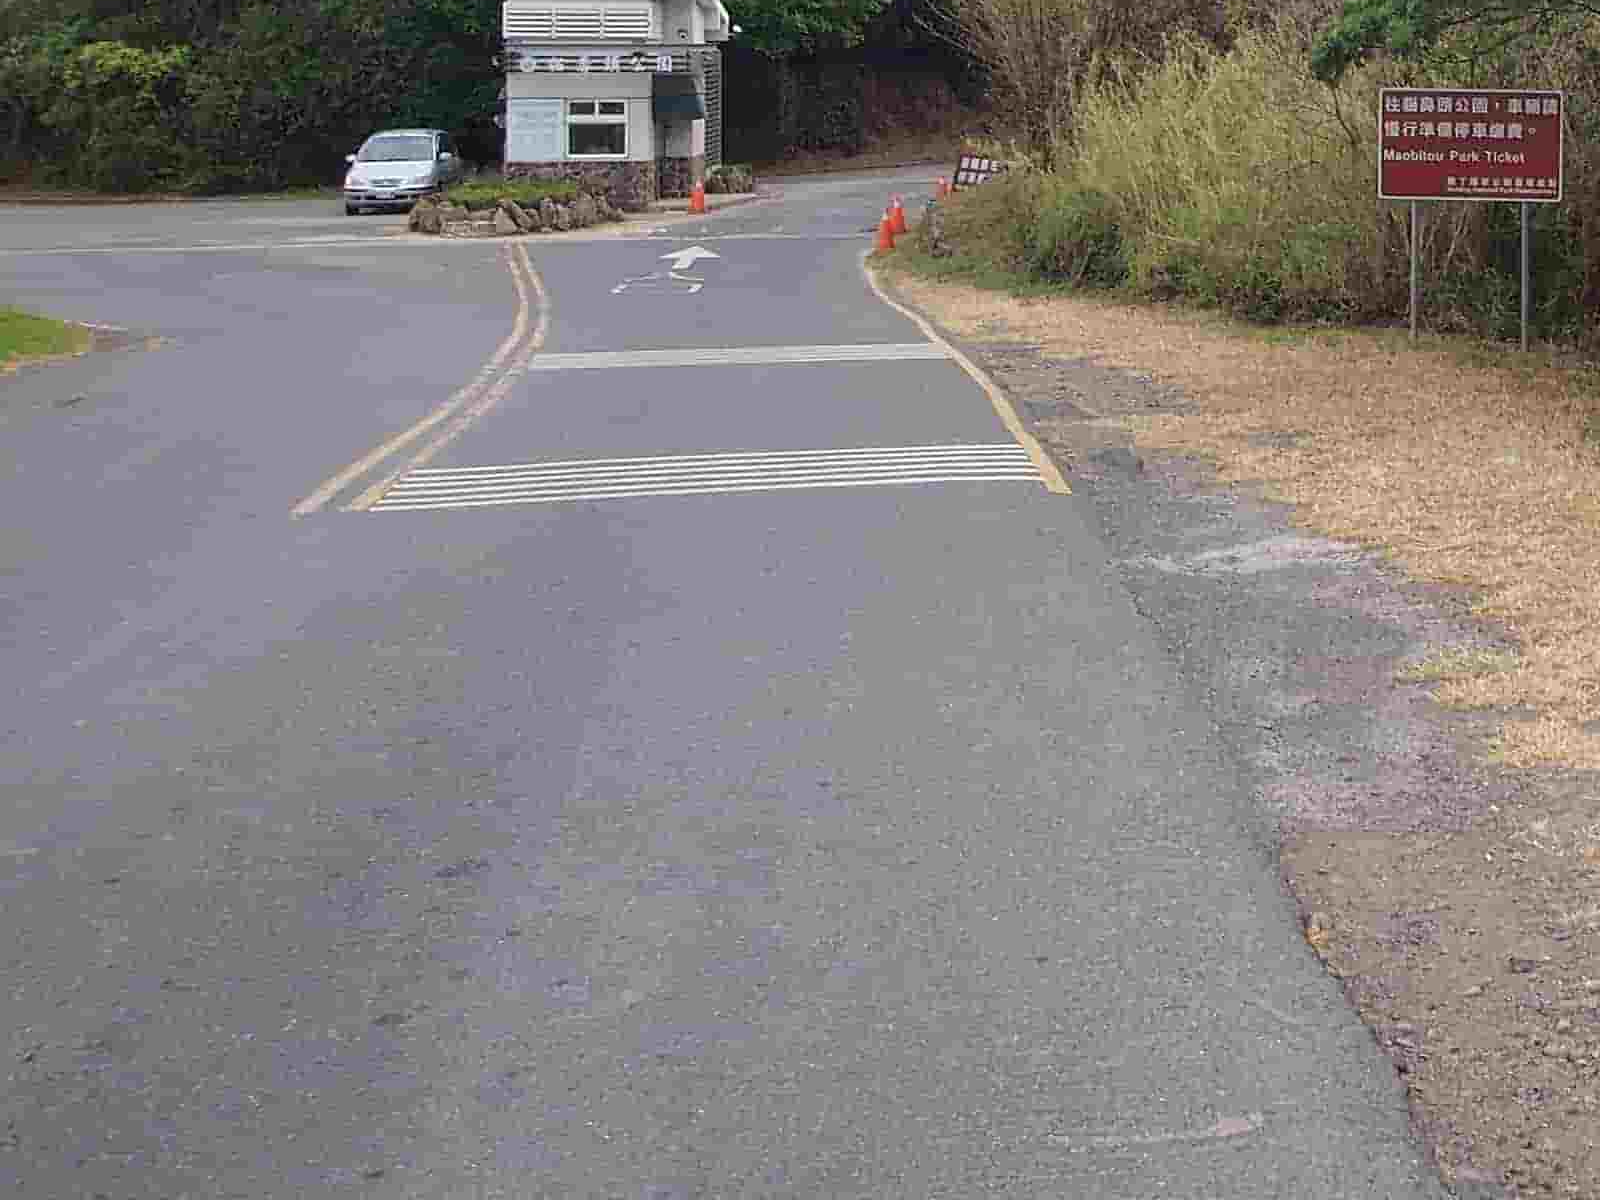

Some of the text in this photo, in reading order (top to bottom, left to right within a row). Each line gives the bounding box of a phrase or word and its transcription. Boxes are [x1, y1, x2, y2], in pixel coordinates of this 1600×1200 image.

[1383, 148, 1526, 165] Maobitou Park Ticket
